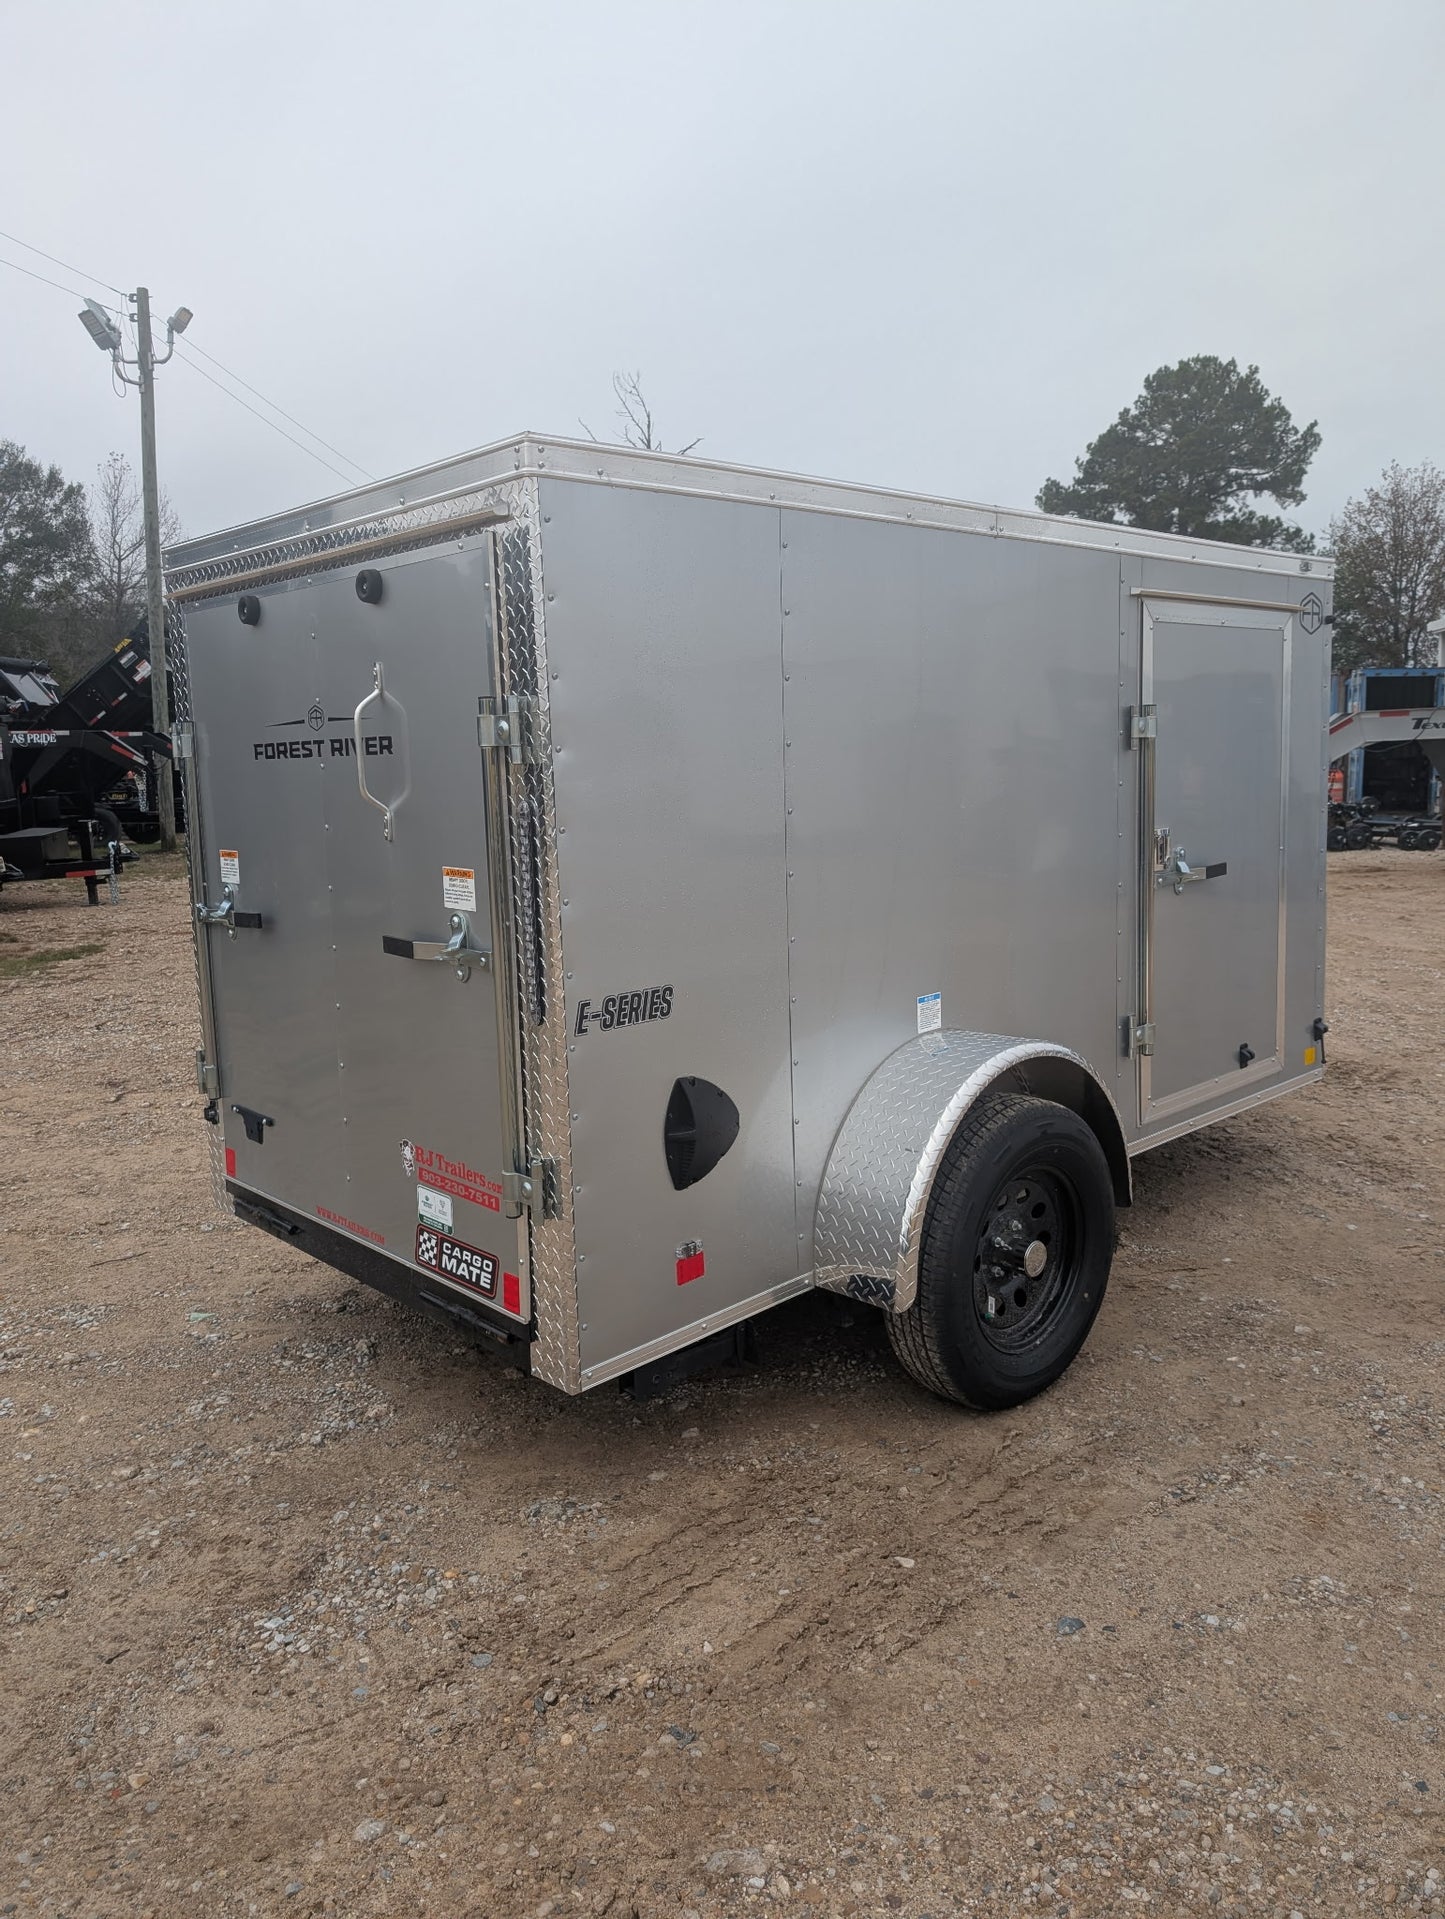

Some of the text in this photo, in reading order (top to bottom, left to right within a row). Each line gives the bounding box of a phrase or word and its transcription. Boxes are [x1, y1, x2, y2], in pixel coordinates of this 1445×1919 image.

[27, 733, 57, 745] PRIDE
[253, 735, 394, 760] FOREST RIVER
[574, 984, 674, 1037] E-SERIES
[415, 1145, 434, 1167] RJ
[421, 1169, 497, 1209] 903-230-7511
[441, 1254, 493, 1289] MATE
[443, 1241, 493, 1273] CARGO
